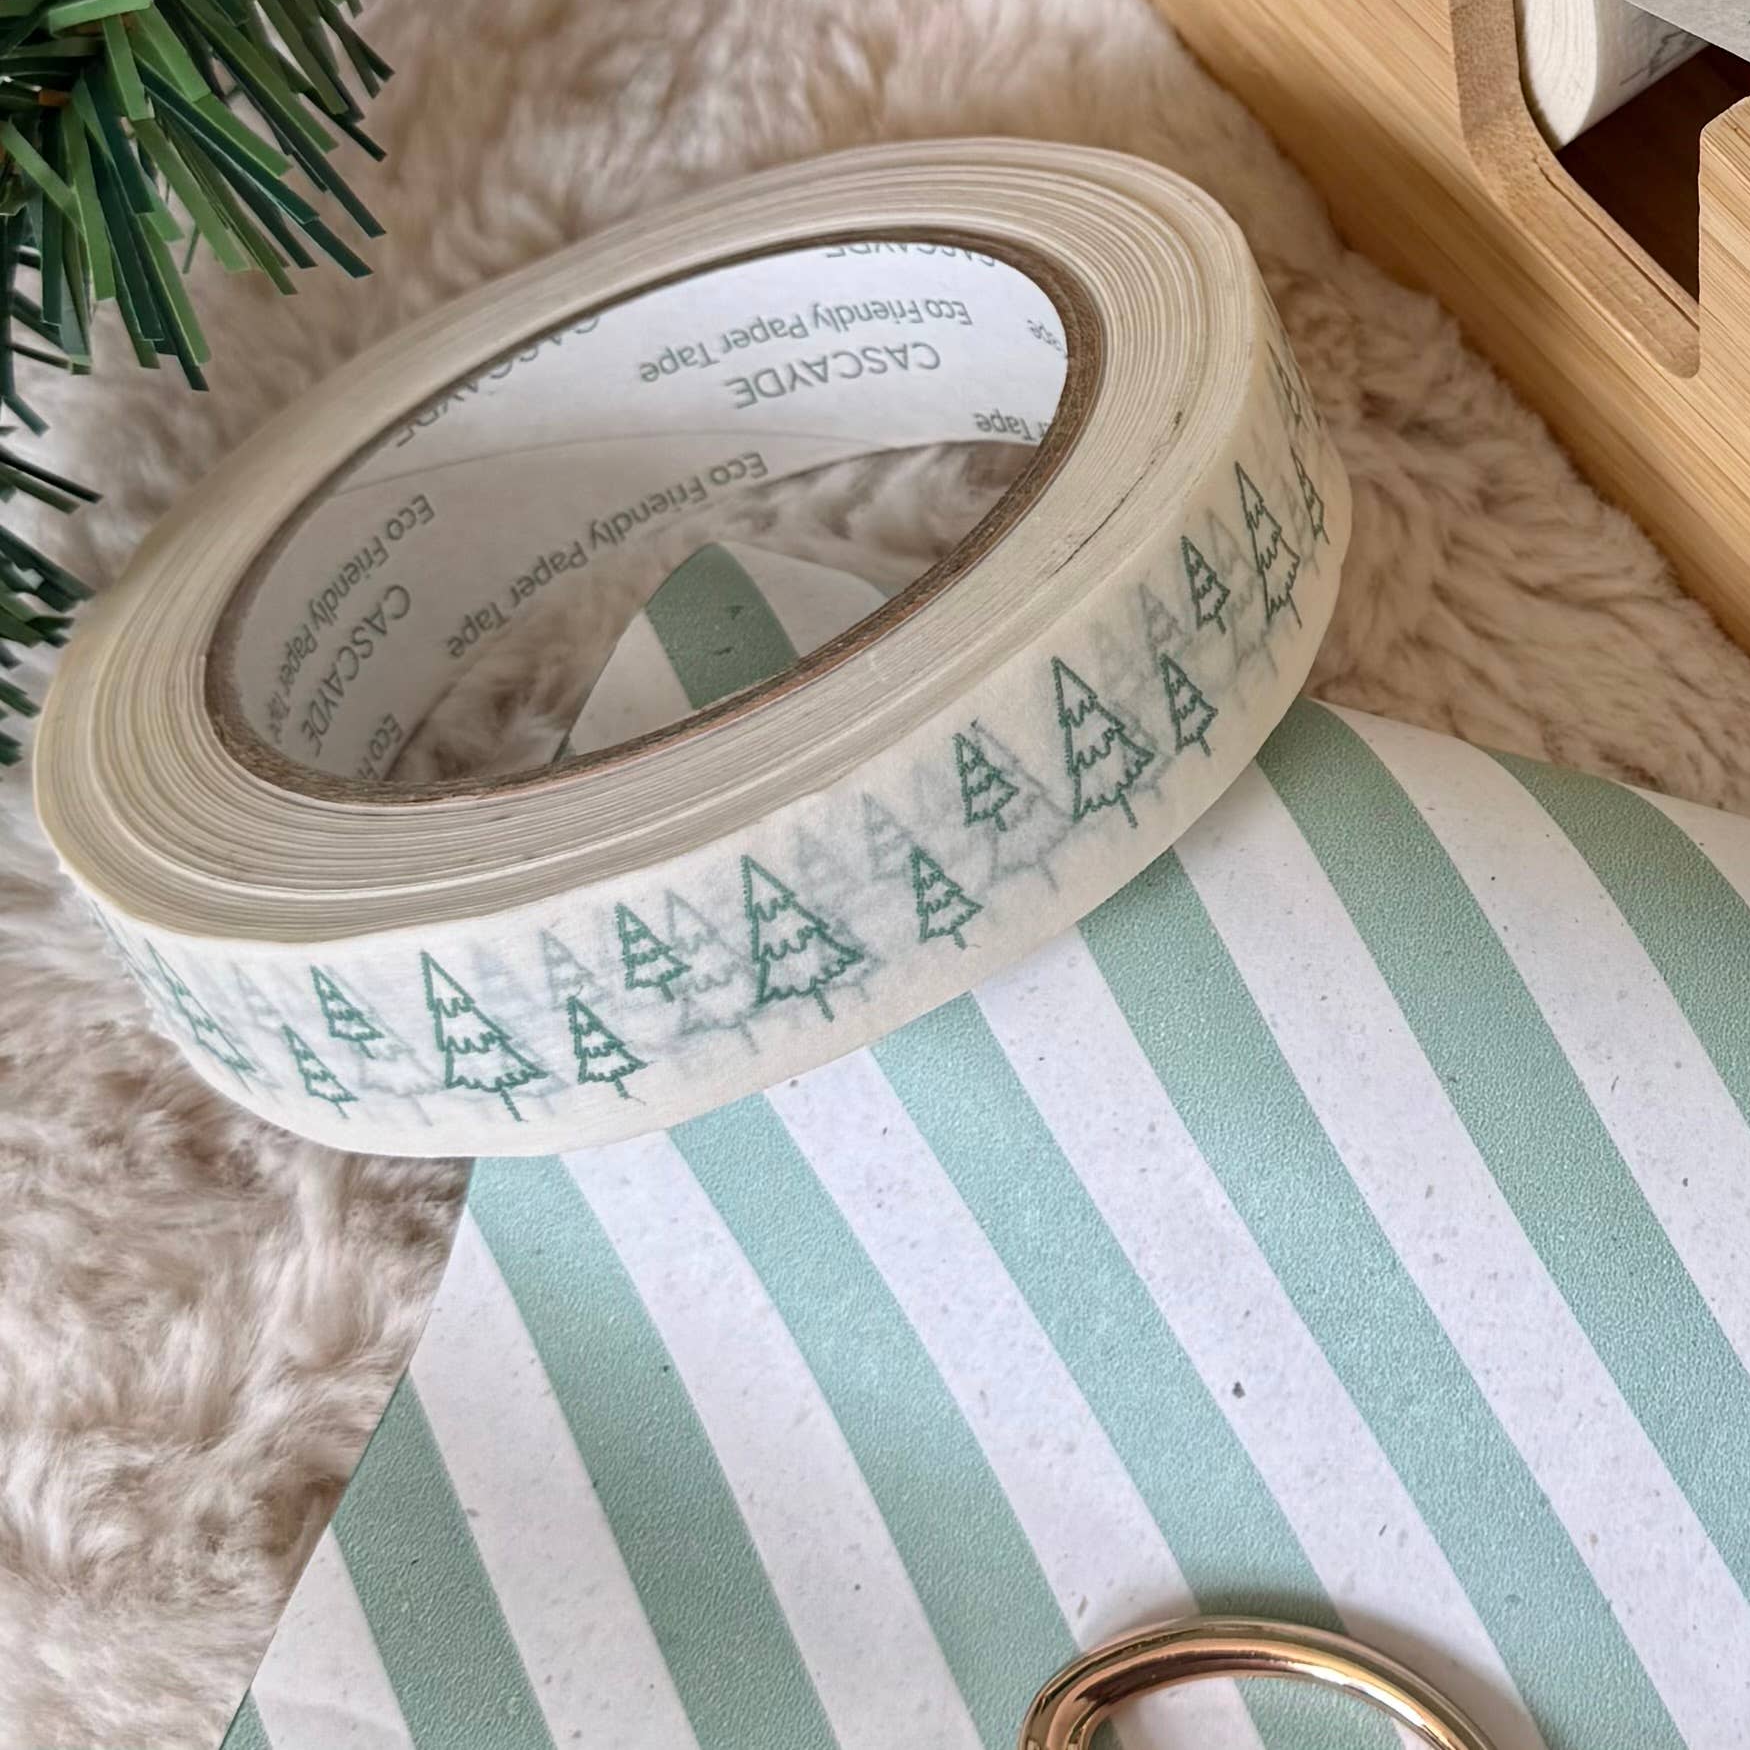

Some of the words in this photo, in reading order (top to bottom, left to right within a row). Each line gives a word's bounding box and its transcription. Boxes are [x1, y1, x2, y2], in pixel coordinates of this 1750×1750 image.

[722, 312, 807, 354] Paper
[813, 300, 922, 331] Friendly
[930, 299, 973, 326] Eco
[640, 344, 719, 384] Tape
[724, 341, 942, 409] CASCAYDE
[709, 451, 768, 485] Eco
[386, 494, 436, 541] Eco
[588, 475, 708, 550] Friendly
[309, 536, 390, 630] Friendly
[510, 541, 589, 607] Paper
[448, 601, 511, 659] Tape
[279, 624, 319, 696] Paper
[301, 584, 412, 757] CASCAYDE
